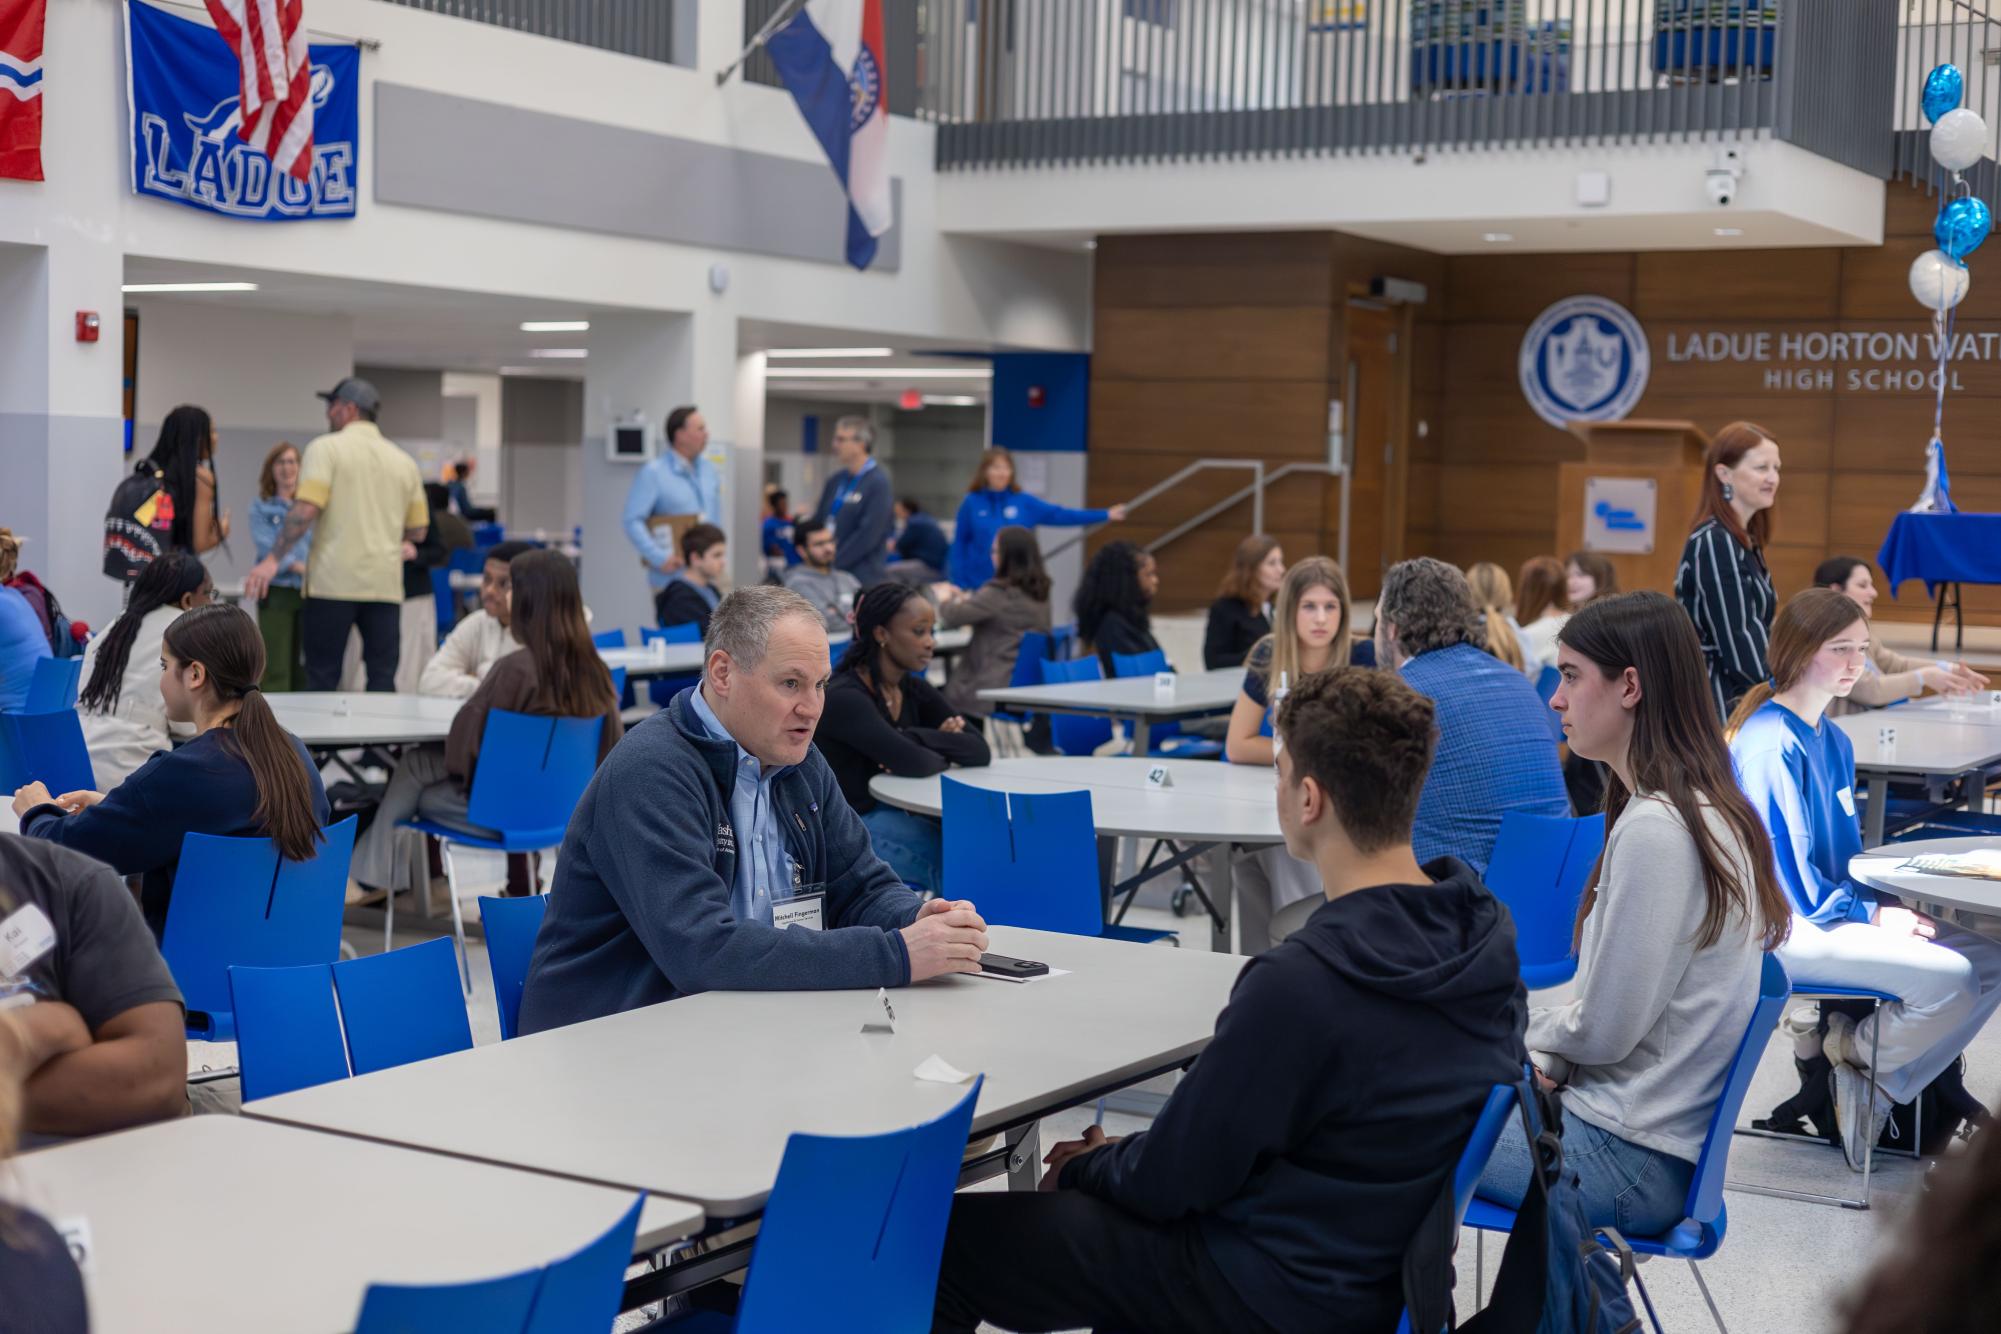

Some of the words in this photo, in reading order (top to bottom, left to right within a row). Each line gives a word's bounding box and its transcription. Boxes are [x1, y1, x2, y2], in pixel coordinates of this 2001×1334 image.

[141, 111, 355, 217] LADUE
[1667, 331, 1771, 362] LADUE
[1779, 331, 1918, 362] HORTON
[1922, 332, 2001, 361] WAT
[1763, 368, 1834, 390] HIGH
[1847, 368, 1965, 391] SCHOOL
[3, 926, 22, 943] Kai
